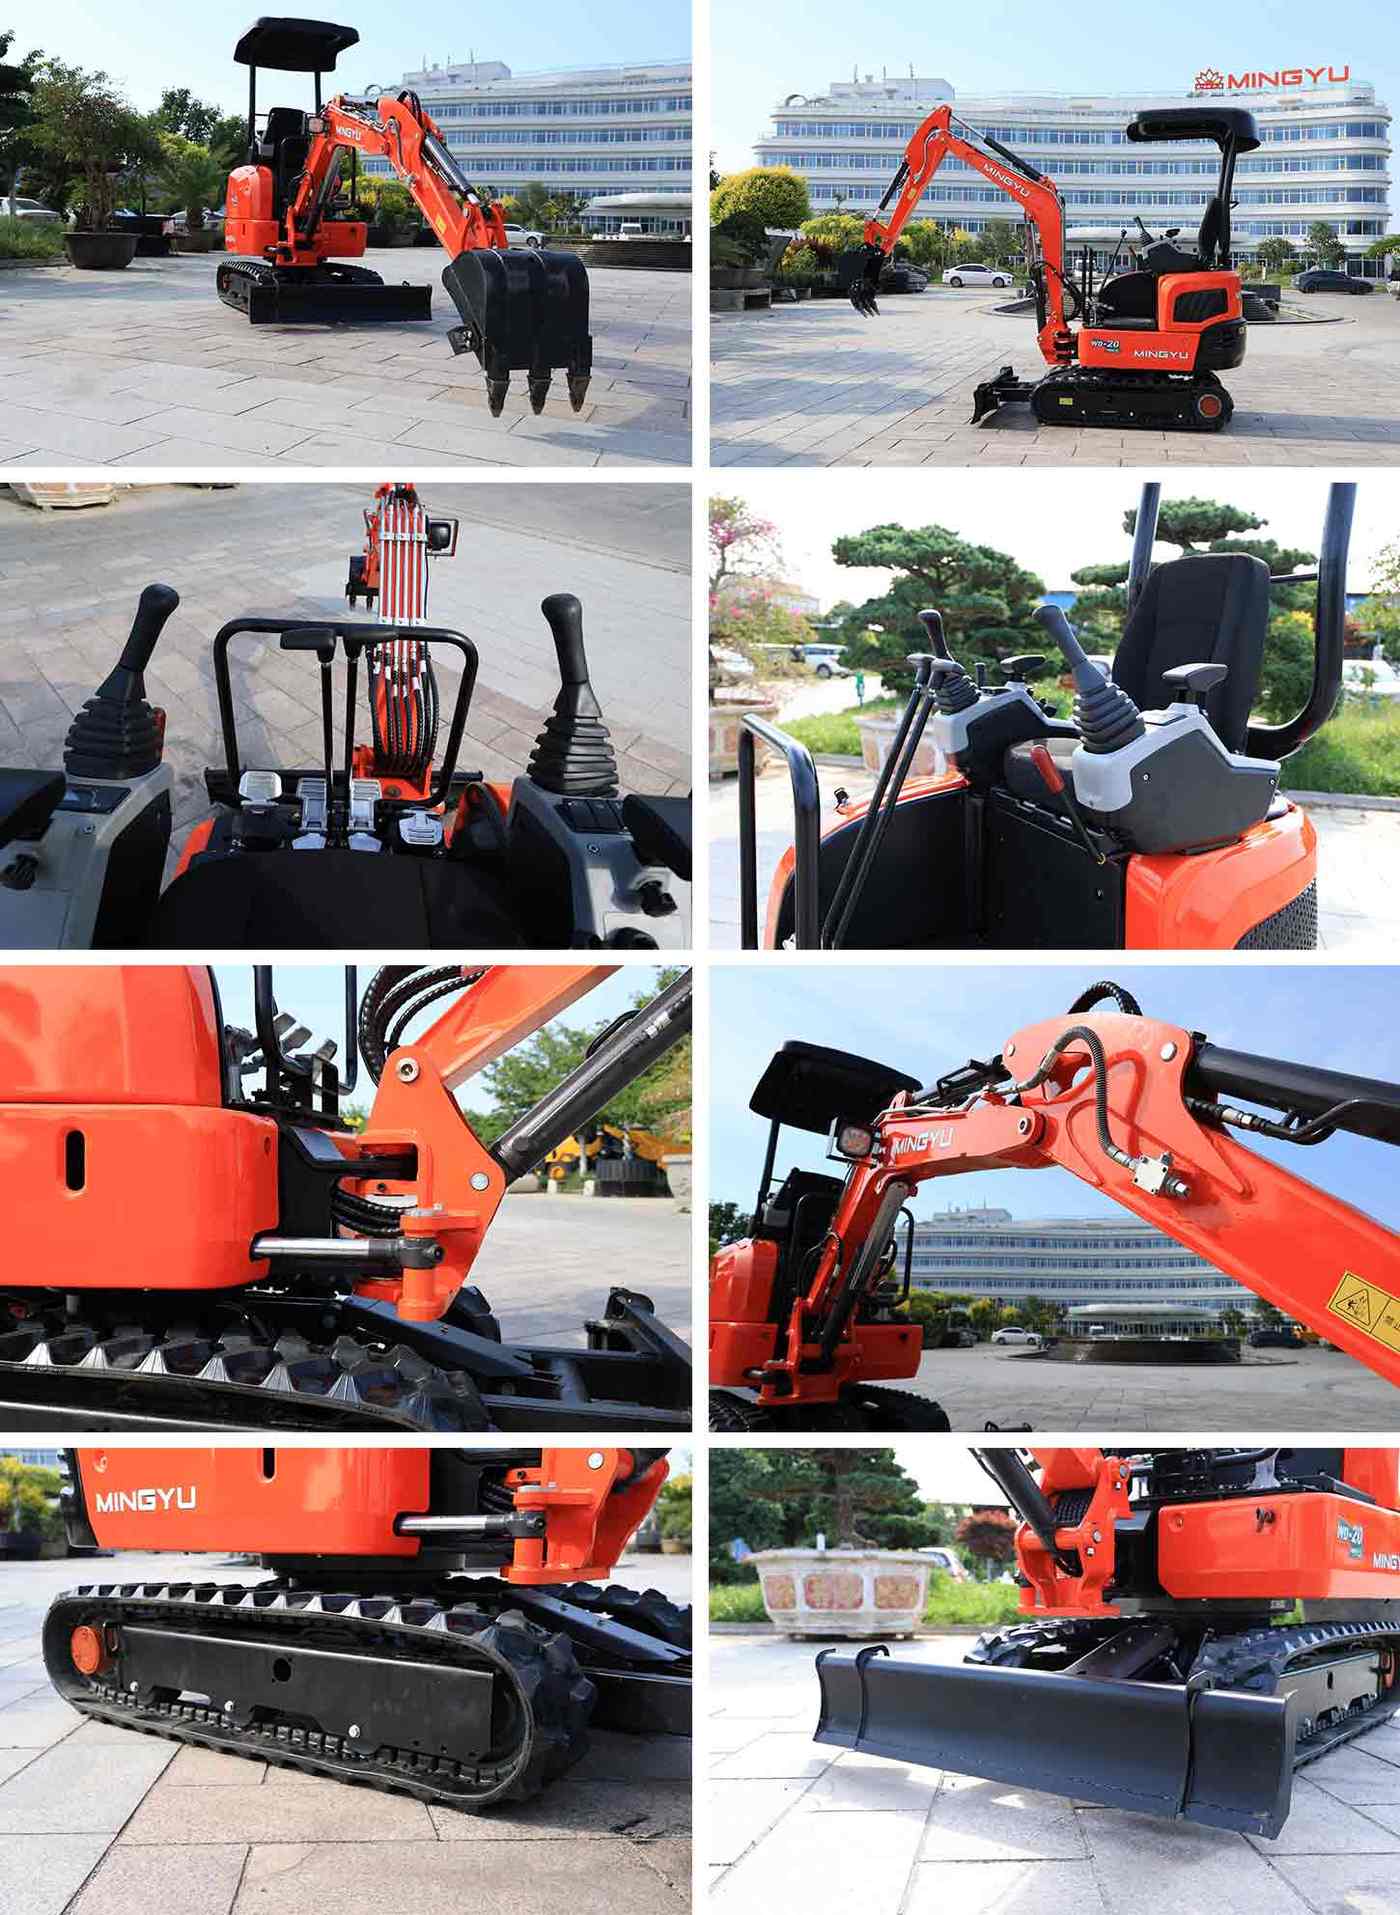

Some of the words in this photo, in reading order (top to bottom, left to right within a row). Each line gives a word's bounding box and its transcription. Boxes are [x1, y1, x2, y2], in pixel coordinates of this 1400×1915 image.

[1227, 65, 1349, 89] MINGYU
[335, 126, 361, 141] MINGYU
[983, 163, 1030, 197] MINGYU
[1134, 350, 1189, 359] MINGYU
[892, 1127, 954, 1153] MINGYU
[95, 1486, 196, 1513] MINGYU
[1372, 1552, 1400, 1570] MING
